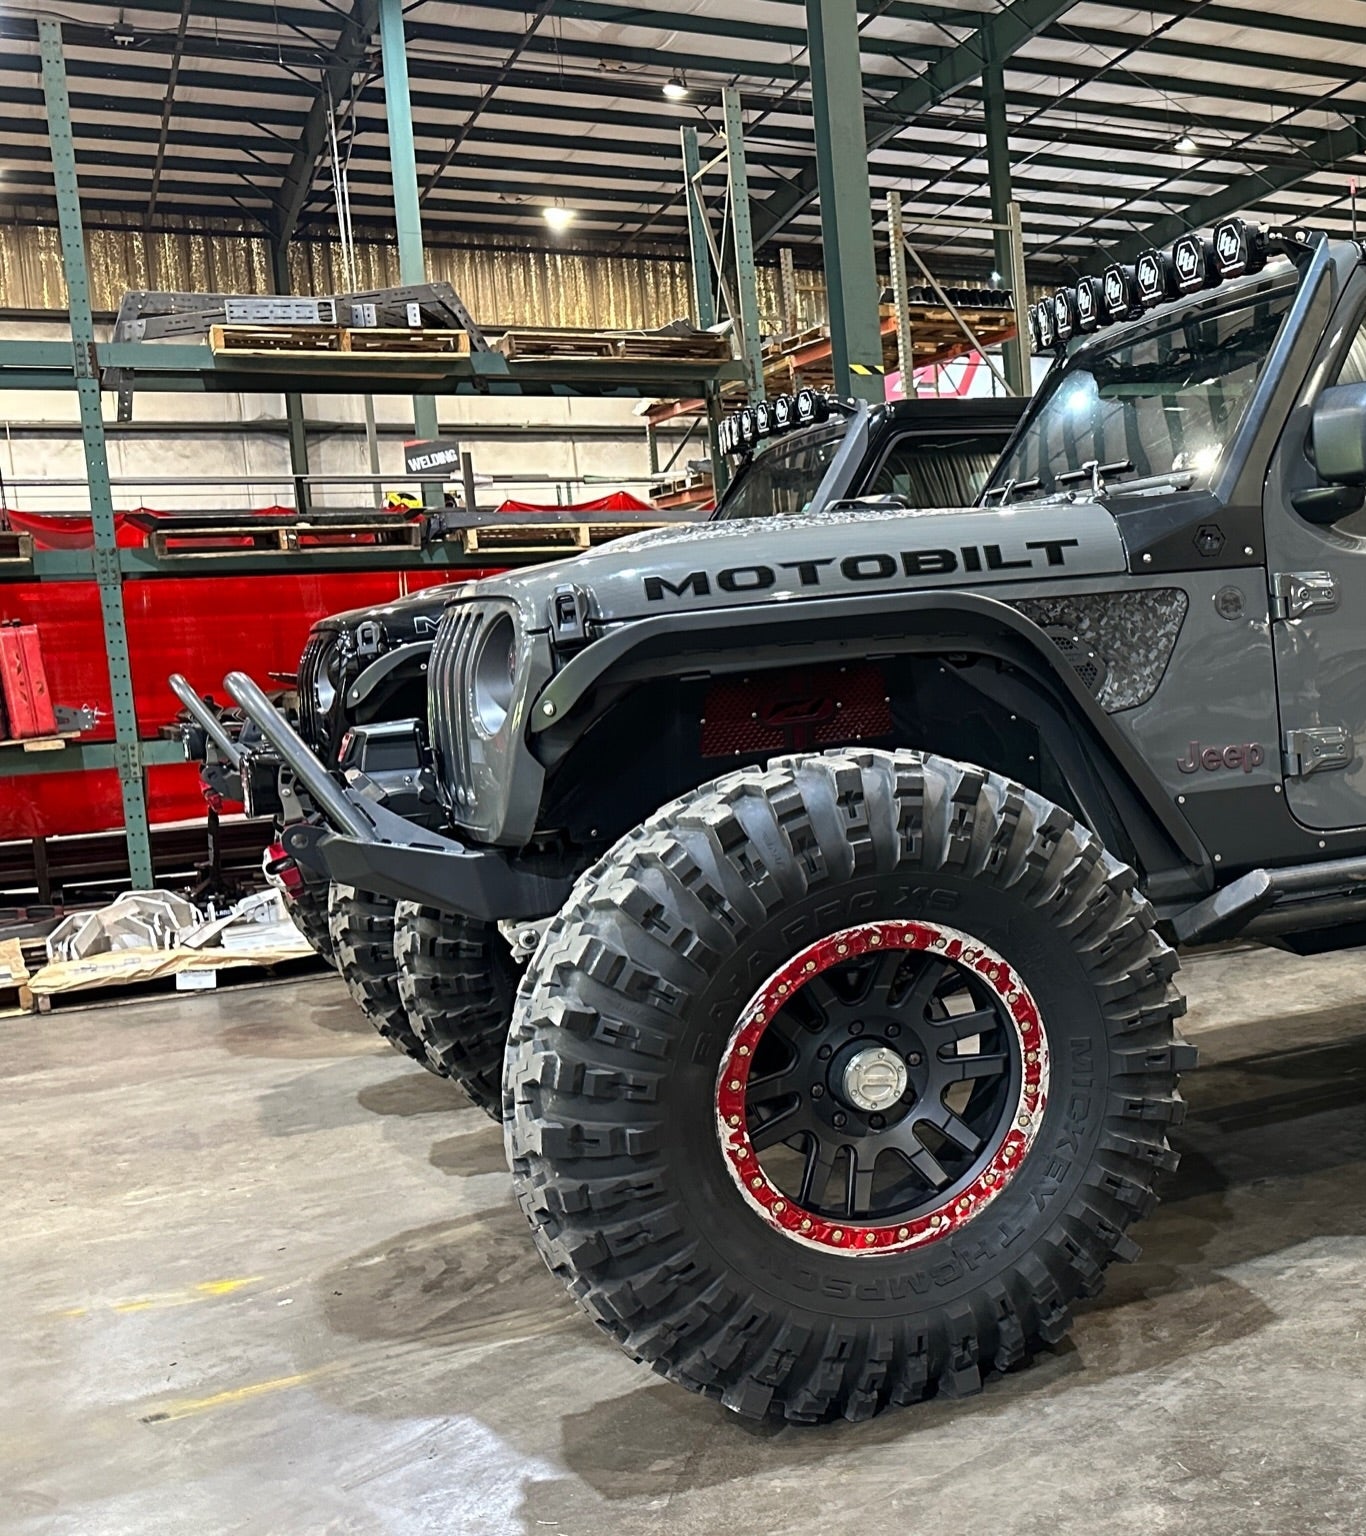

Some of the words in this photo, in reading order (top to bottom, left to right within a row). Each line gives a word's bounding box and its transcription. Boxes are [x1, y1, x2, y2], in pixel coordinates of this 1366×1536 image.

[407, 449, 458, 472] WELDING
[643, 538, 1079, 601] MOTOBILT
[1176, 740, 1265, 774] Jeep
[1029, 1036, 1096, 1213] MICKEY
